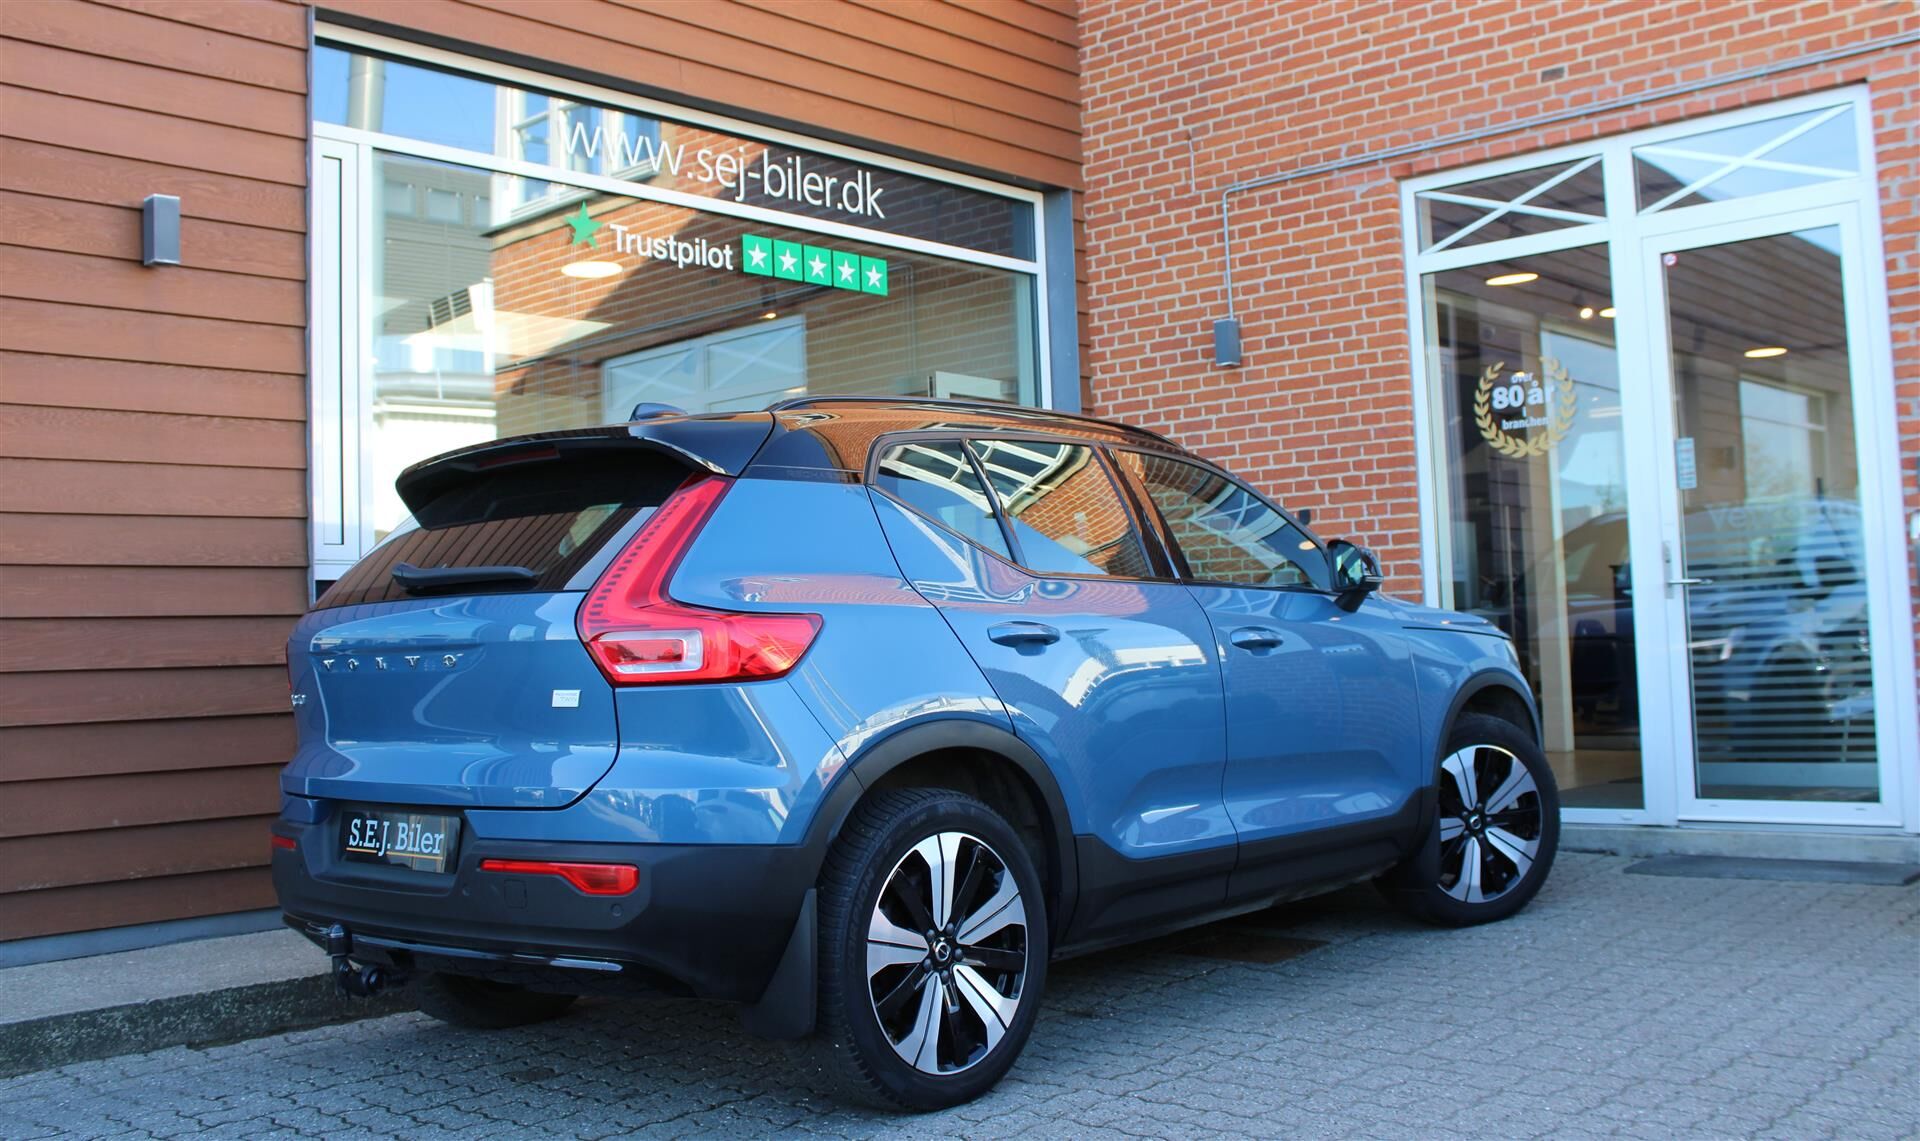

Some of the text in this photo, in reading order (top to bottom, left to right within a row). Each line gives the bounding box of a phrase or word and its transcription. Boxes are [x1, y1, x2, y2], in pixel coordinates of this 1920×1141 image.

[559, 119, 886, 219] www.sej-biler.dk
[609, 223, 734, 271] Trustpilot
[1492, 380, 1555, 410] 80 år
[348, 818, 445, 857] S.E.J. Biler
